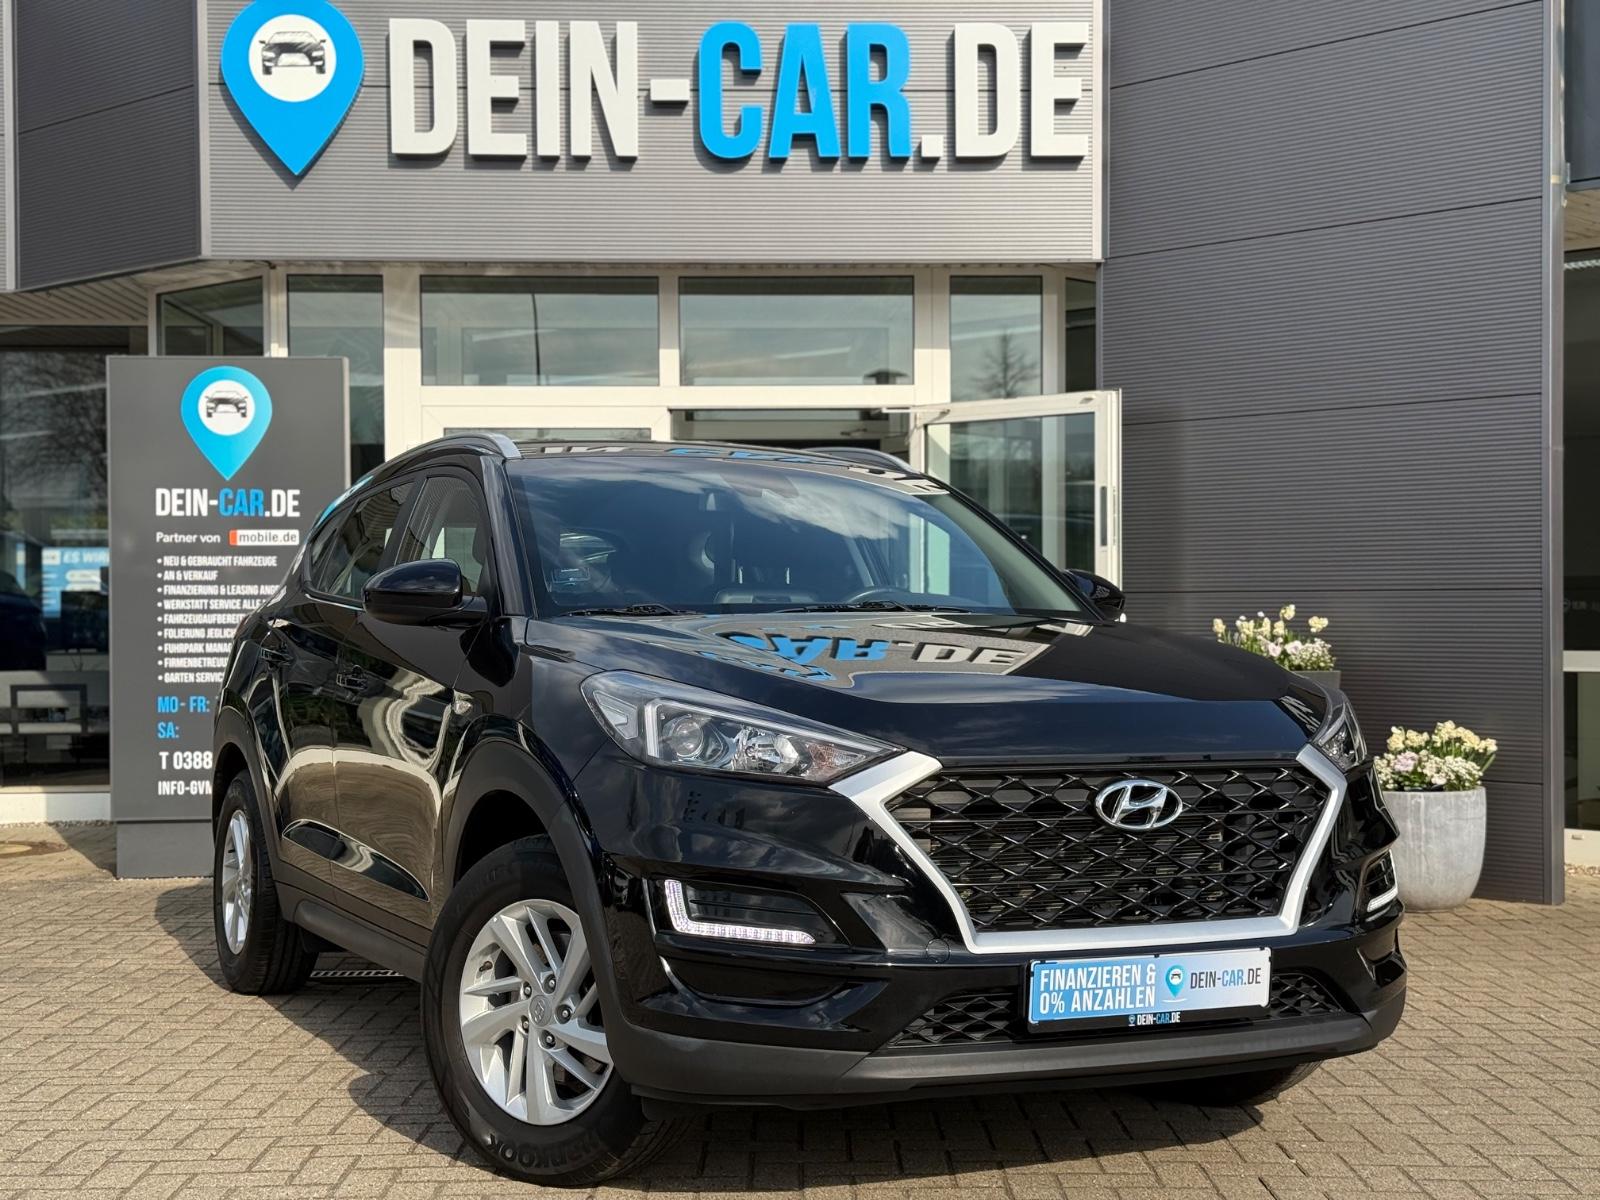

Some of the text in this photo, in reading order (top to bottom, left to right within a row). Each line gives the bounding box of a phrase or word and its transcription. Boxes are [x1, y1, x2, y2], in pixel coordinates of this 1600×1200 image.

[388, 18, 1090, 159] DEIN-CAR.DE
[155, 487, 301, 517] DEIN-CAR.DE
[156, 532, 297, 543] Partner von mobile.de
[163, 556, 278, 567] NEU & GEBRAUCHT FAHRZEUGE
[163, 570, 219, 581] AN & VERKAUF
[163, 585, 219, 595] FINANZIERUNG
[220, 585, 226, 595] &
[227, 585, 259, 595] LEASING
[163, 599, 208, 610] WERKSTATT
[209, 599, 241, 610] SERVICE
[163, 628, 206, 639] FOLIERUNG
[163, 643, 205, 653] FUHRPARK
[164, 672, 194, 683] GARTEN
[189, 696, 210, 713] FR:
[157, 722, 179, 738] SA:
[159, 751, 213, 770] T 0388
[1040, 963, 1157, 992] FINANZIEREN &
[1190, 967, 1262, 990] DEIN-CAR.DE
[1039, 986, 1156, 1015] 0% ANZAHLEN
[1136, 1011, 1181, 1026] DEIN-CAR.DE
